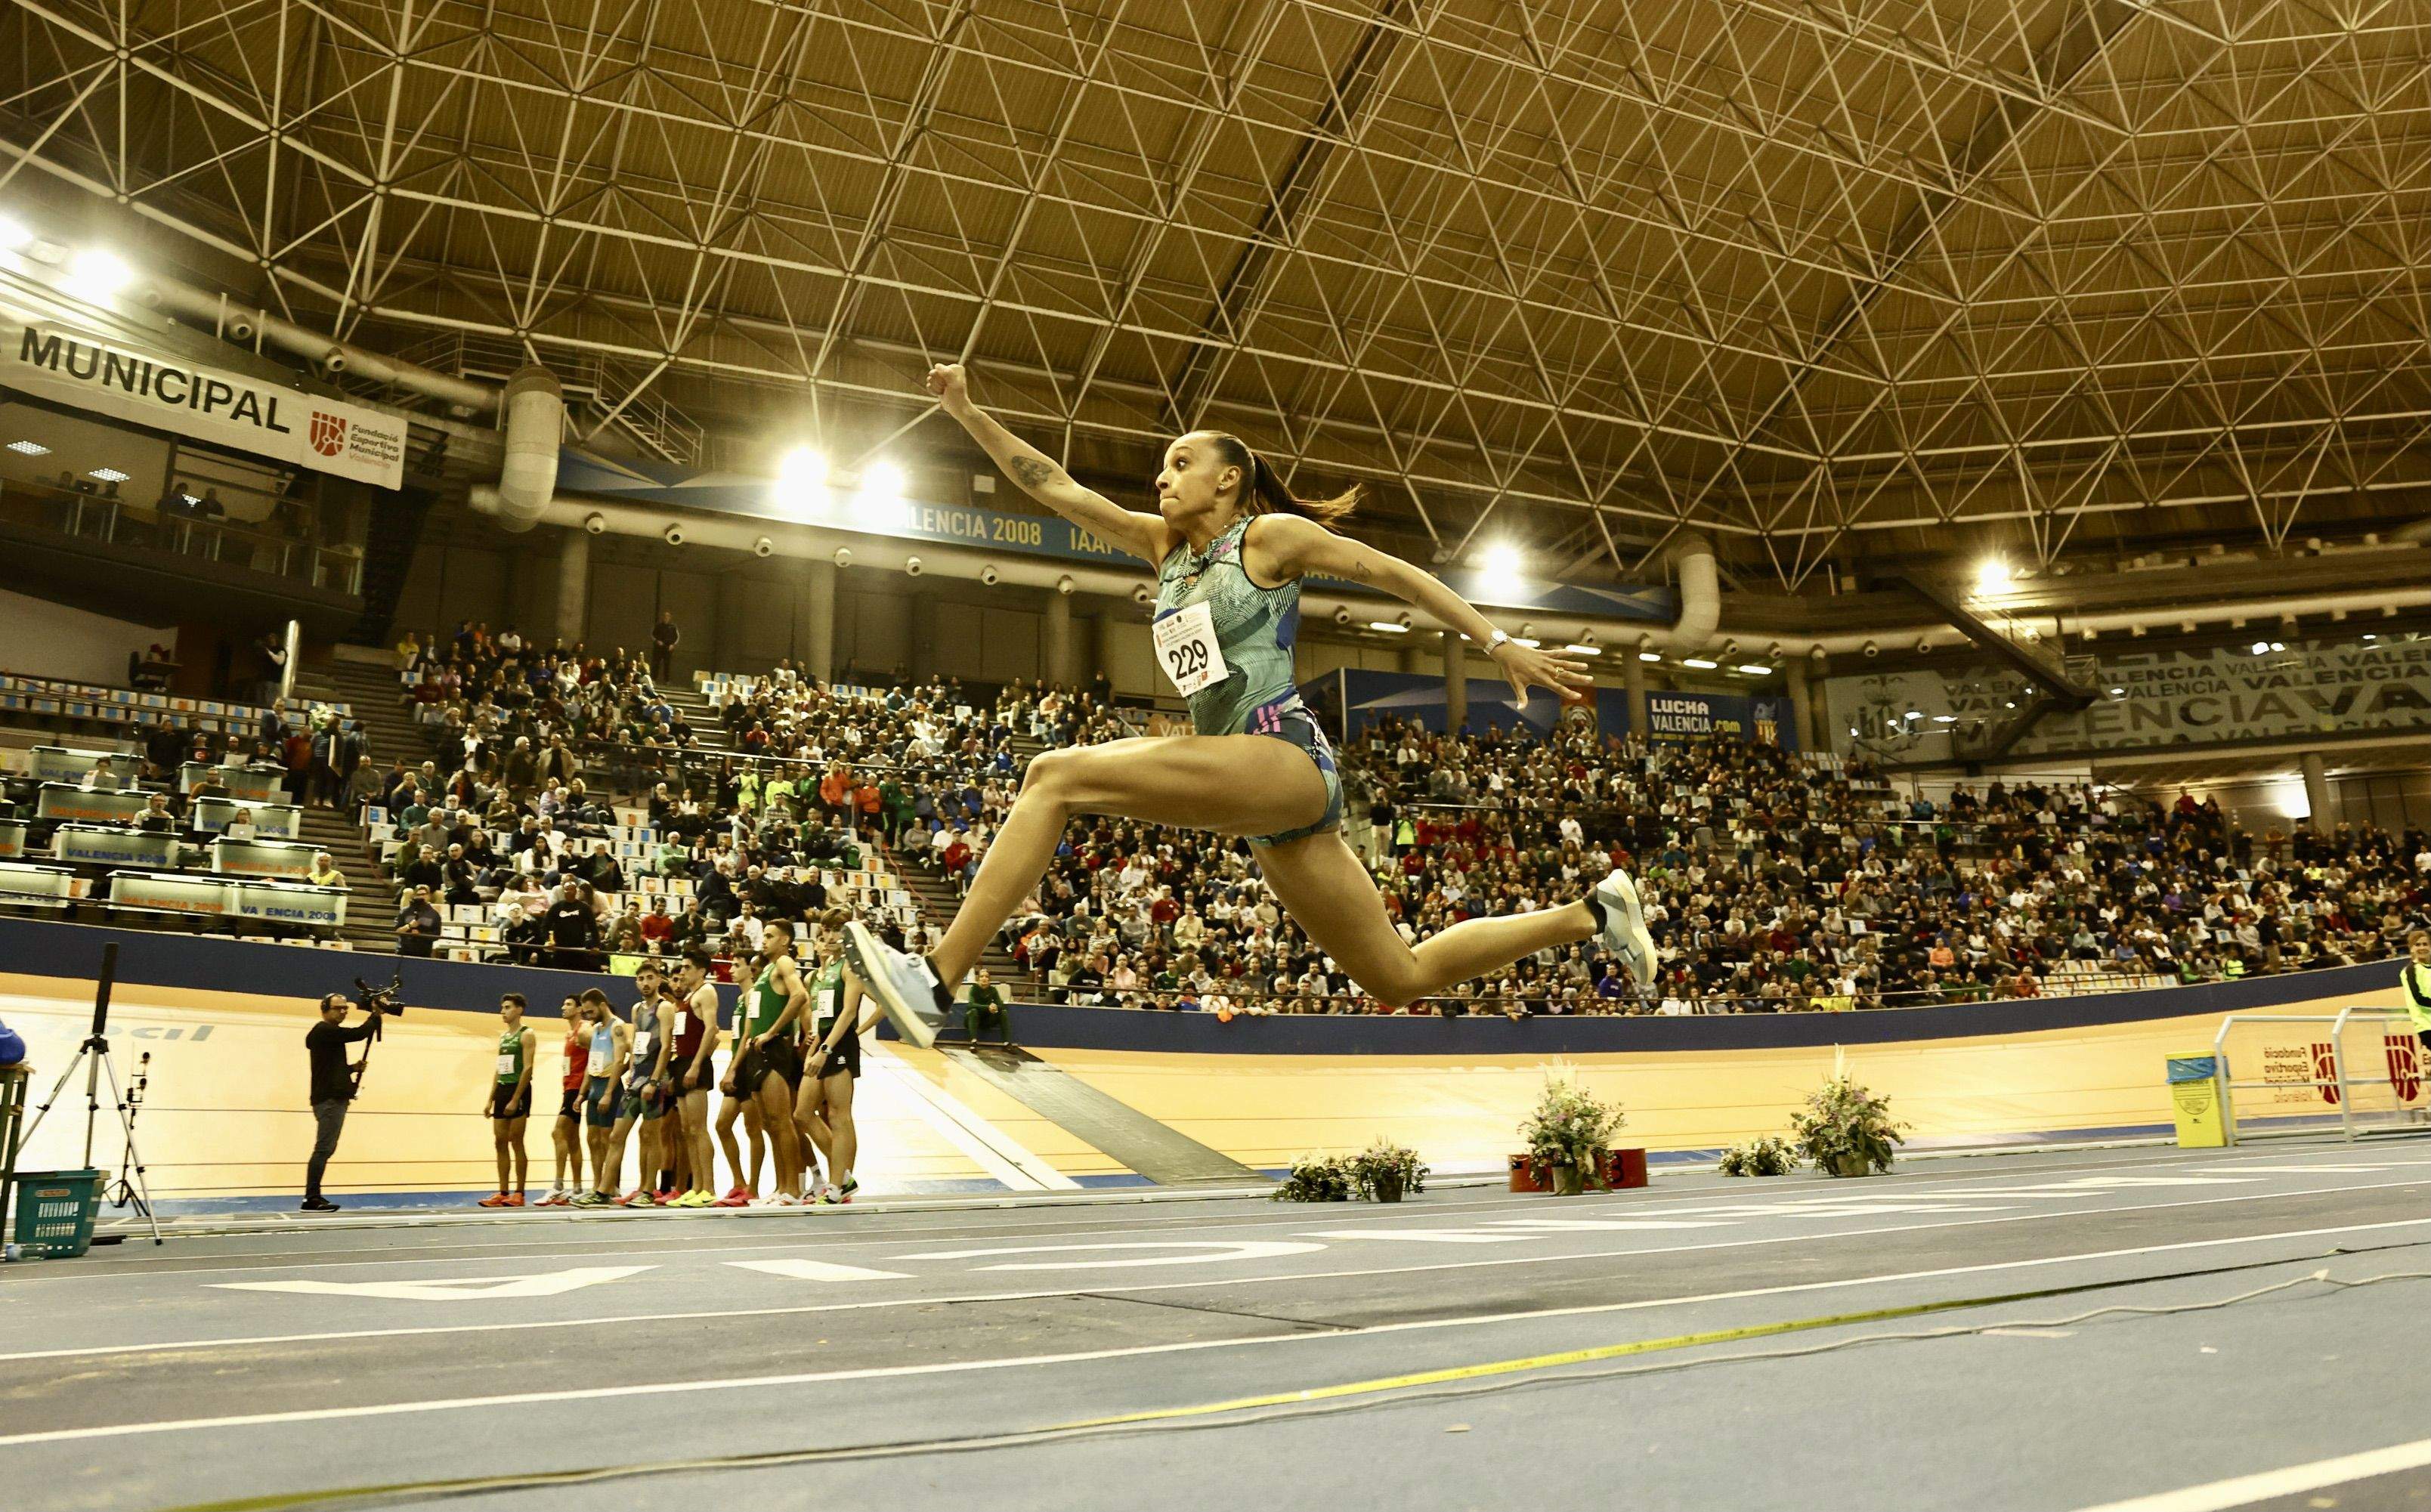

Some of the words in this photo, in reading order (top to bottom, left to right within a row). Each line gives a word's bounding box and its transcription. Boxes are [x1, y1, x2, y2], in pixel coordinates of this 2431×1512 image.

[20, 326, 290, 434] MUNICIPAL
[350, 433, 399, 453] Esportiva
[351, 424, 398, 443] Fundació
[349, 442, 400, 462] Municipal
[992, 517, 1042, 546] 2008
[1168, 639, 1208, 680] 229
[2242, 665, 2430, 691] VALENCIA
[1651, 699, 1709, 715] LUCHA
[66, 848, 133, 861] VALENCIA
[308, 911, 336, 921] 2008
